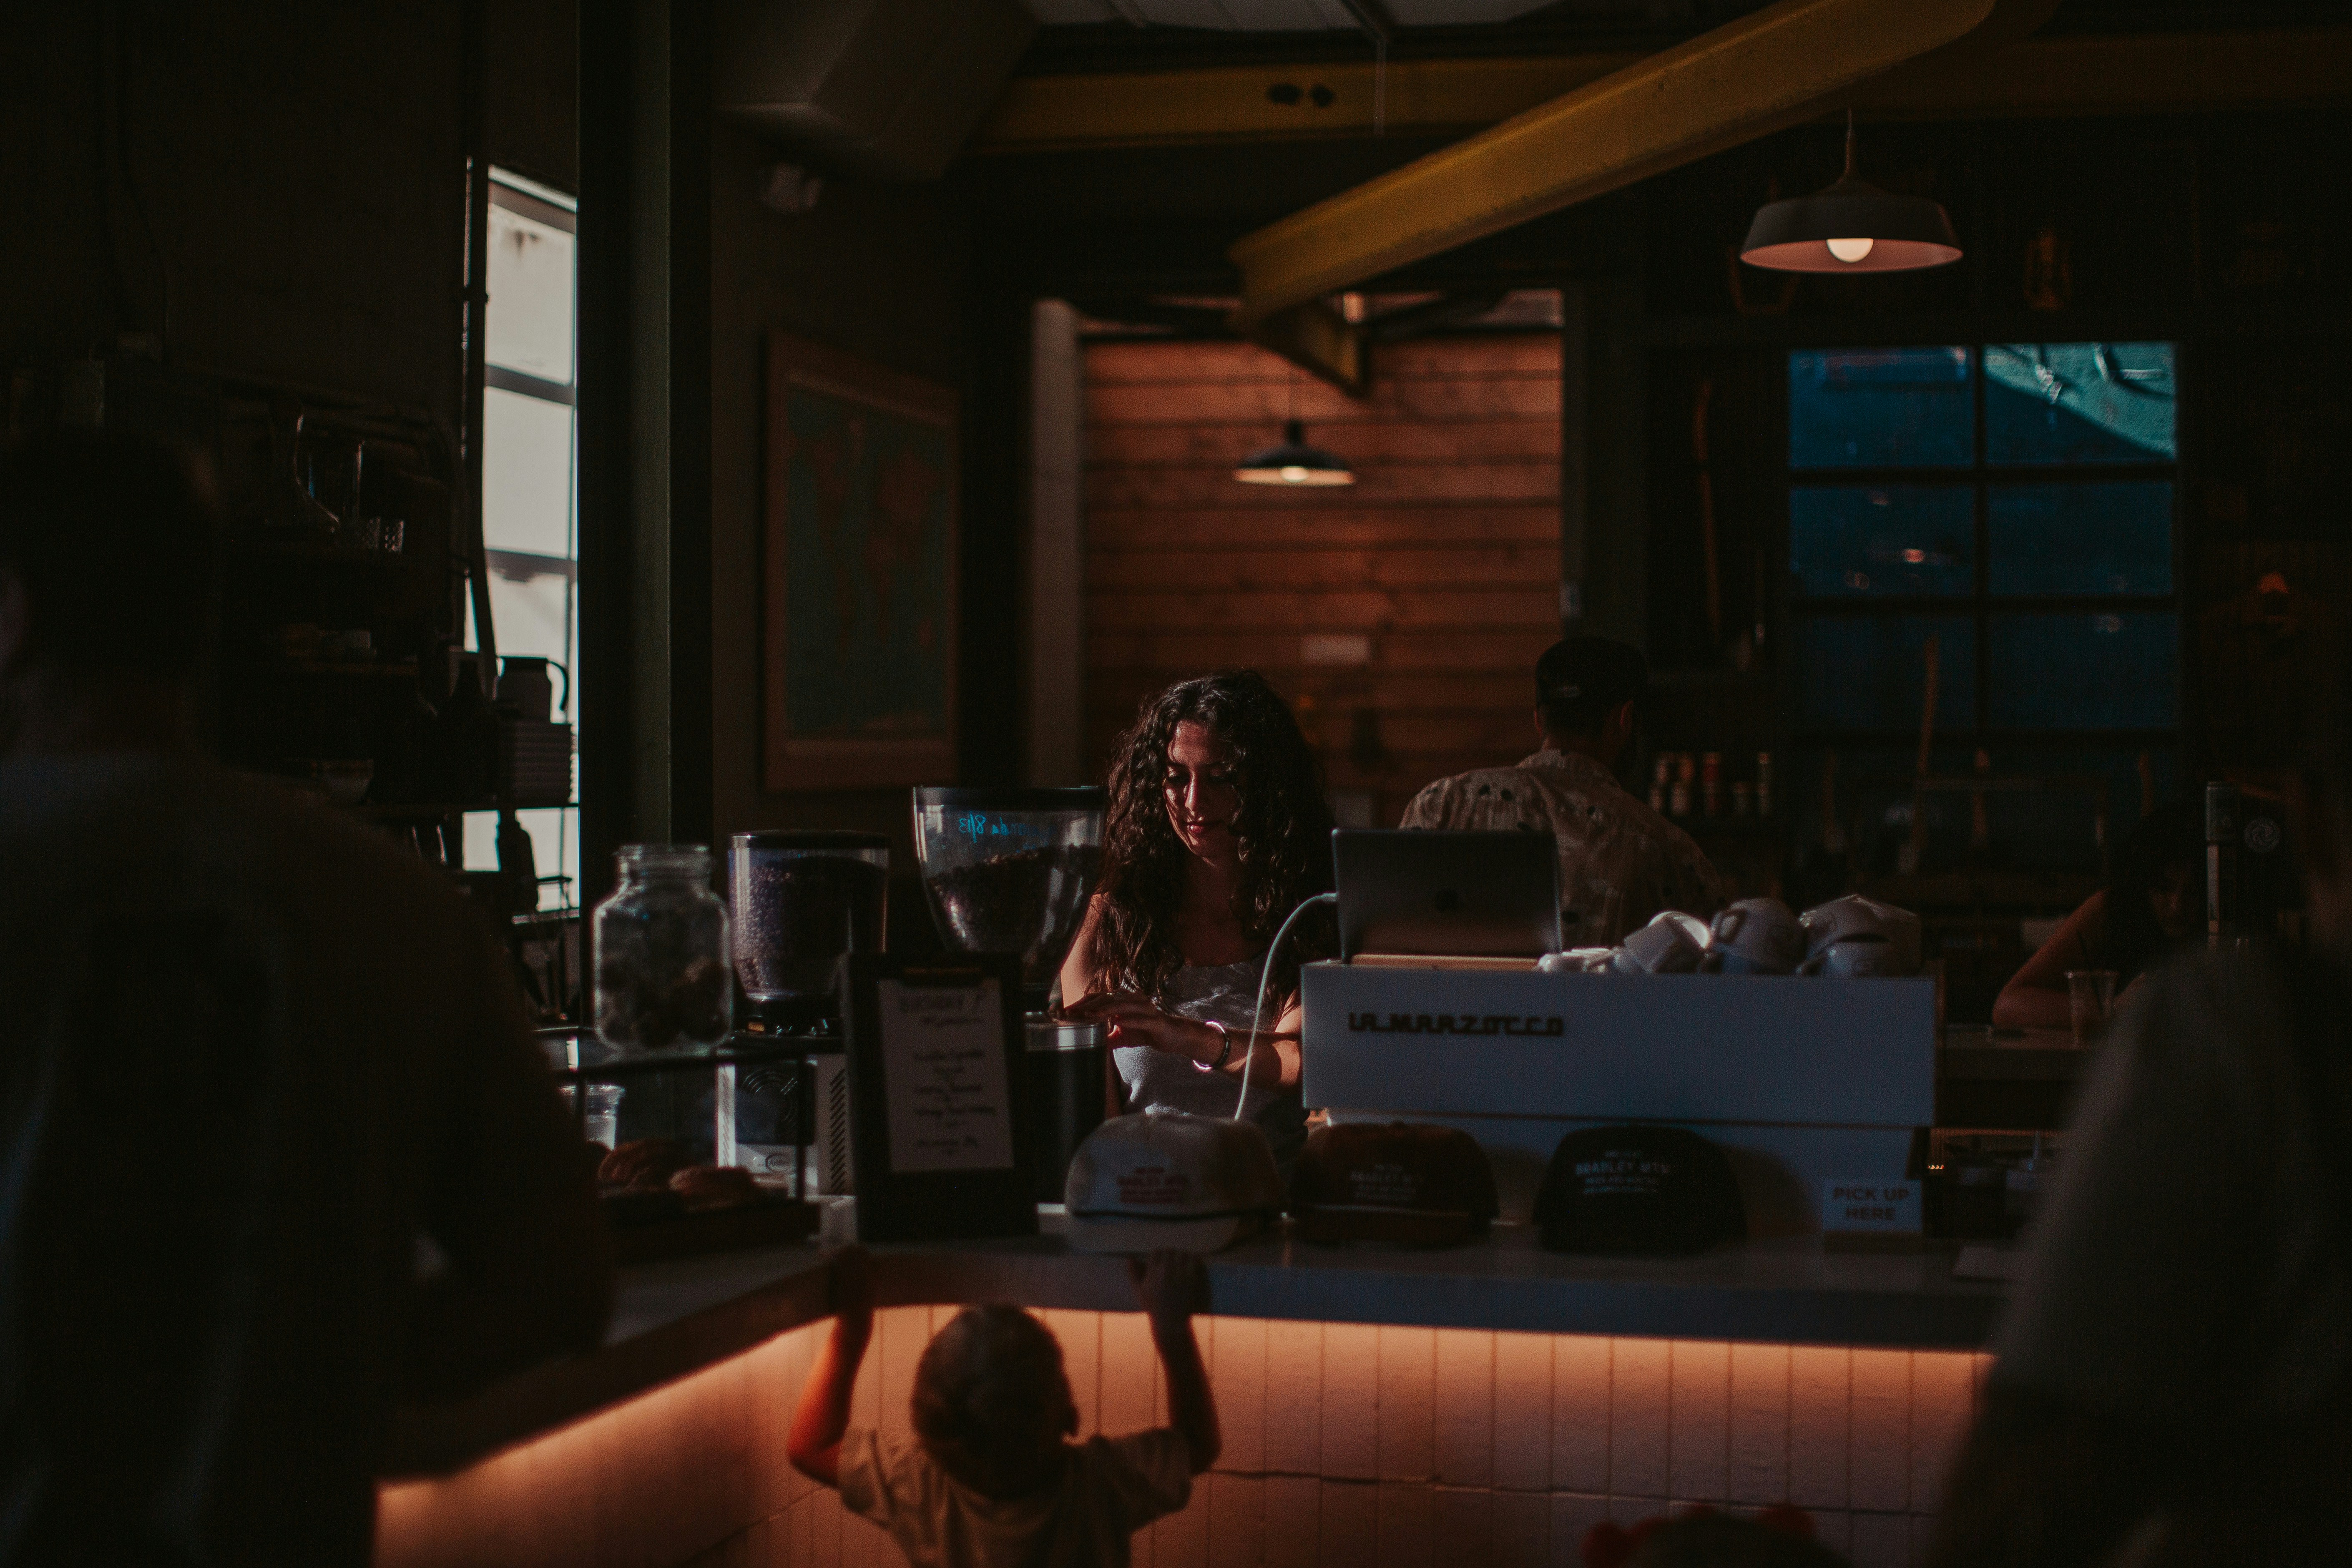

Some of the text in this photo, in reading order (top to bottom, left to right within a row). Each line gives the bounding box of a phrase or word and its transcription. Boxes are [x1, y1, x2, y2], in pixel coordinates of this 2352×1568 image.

[1833, 1187, 1909, 1201] PICK UP
[1845, 1207, 1895, 1220] HERE
